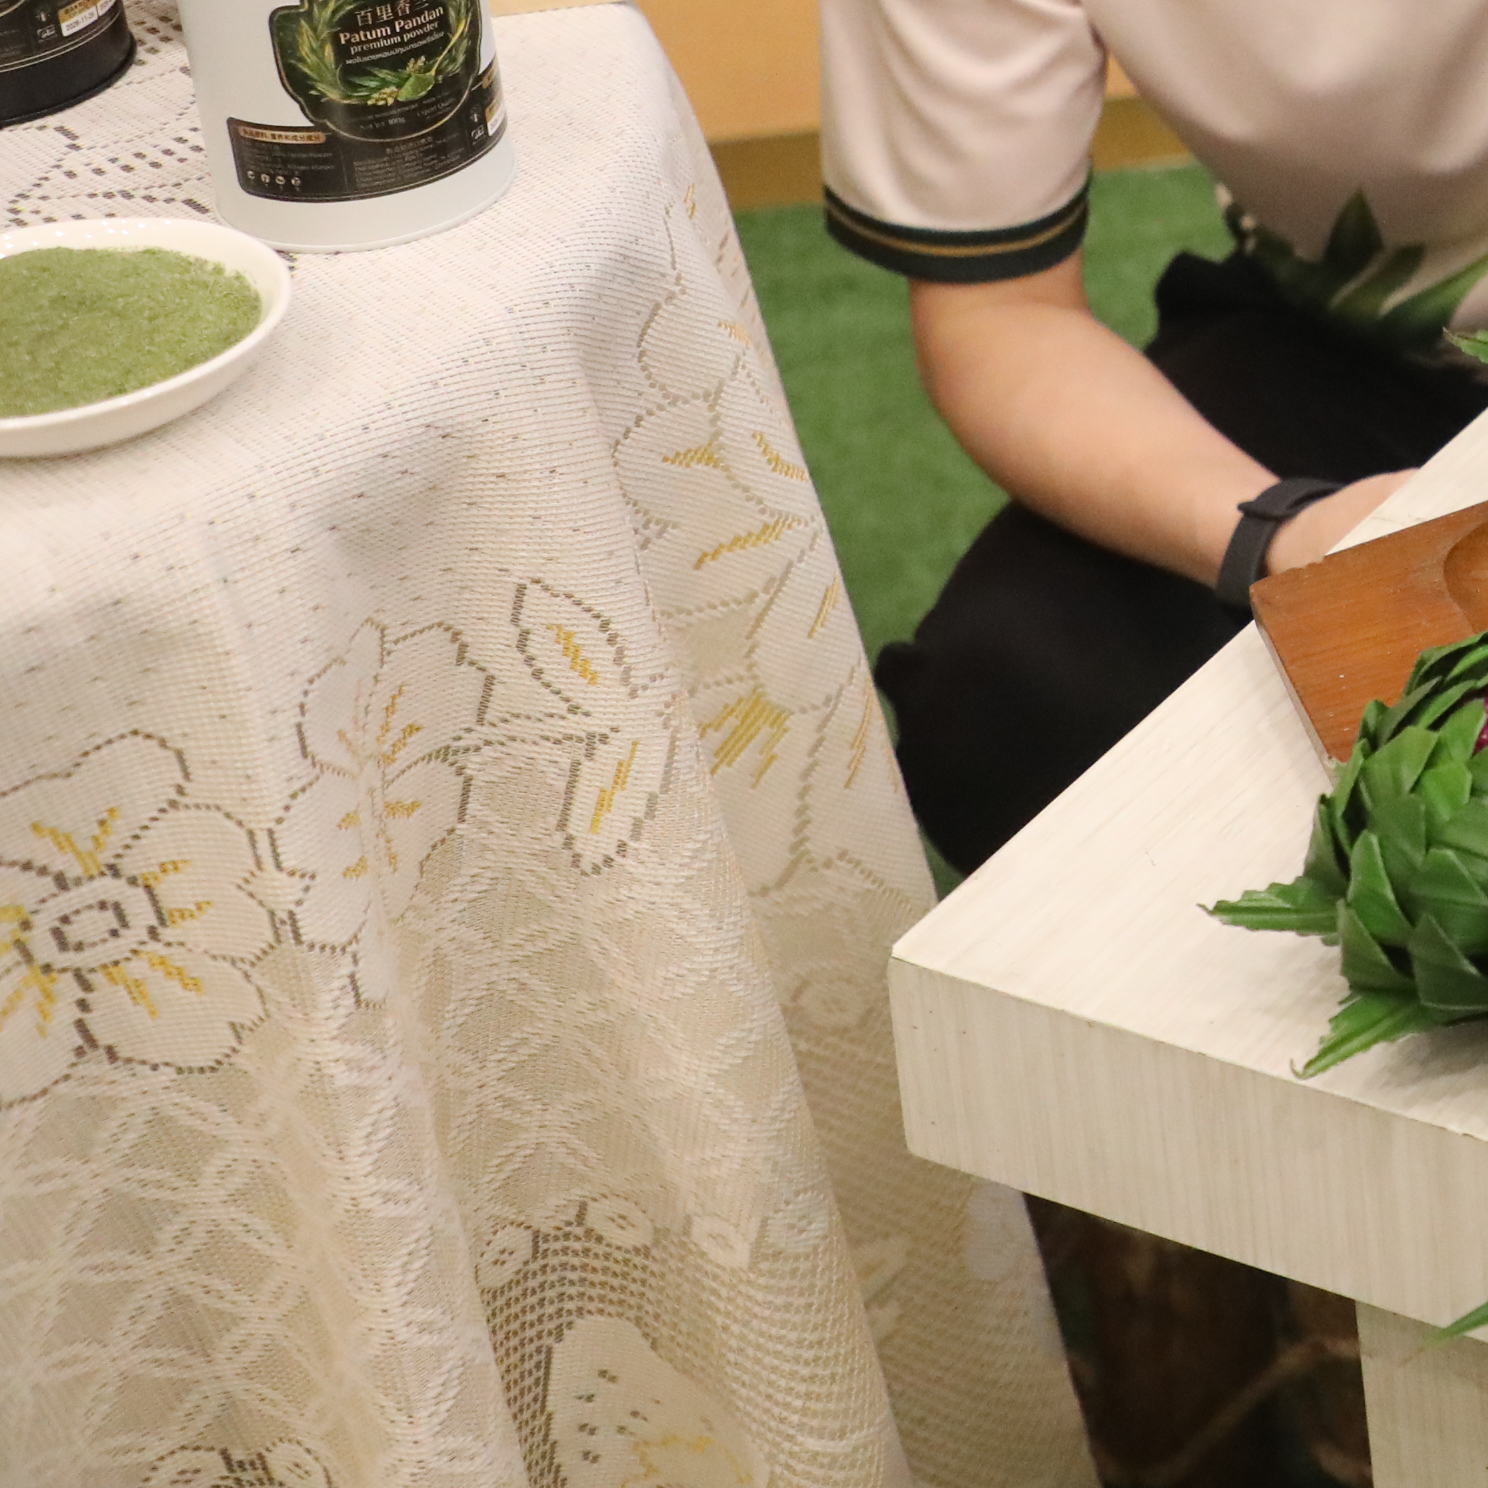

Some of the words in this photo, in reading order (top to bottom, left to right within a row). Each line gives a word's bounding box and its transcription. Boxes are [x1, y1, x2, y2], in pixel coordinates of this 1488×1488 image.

[339, 26, 391, 45] Patum
[394, 6, 444, 32] Pandan
[350, 35, 401, 55] premium
[403, 21, 440, 42] powder
